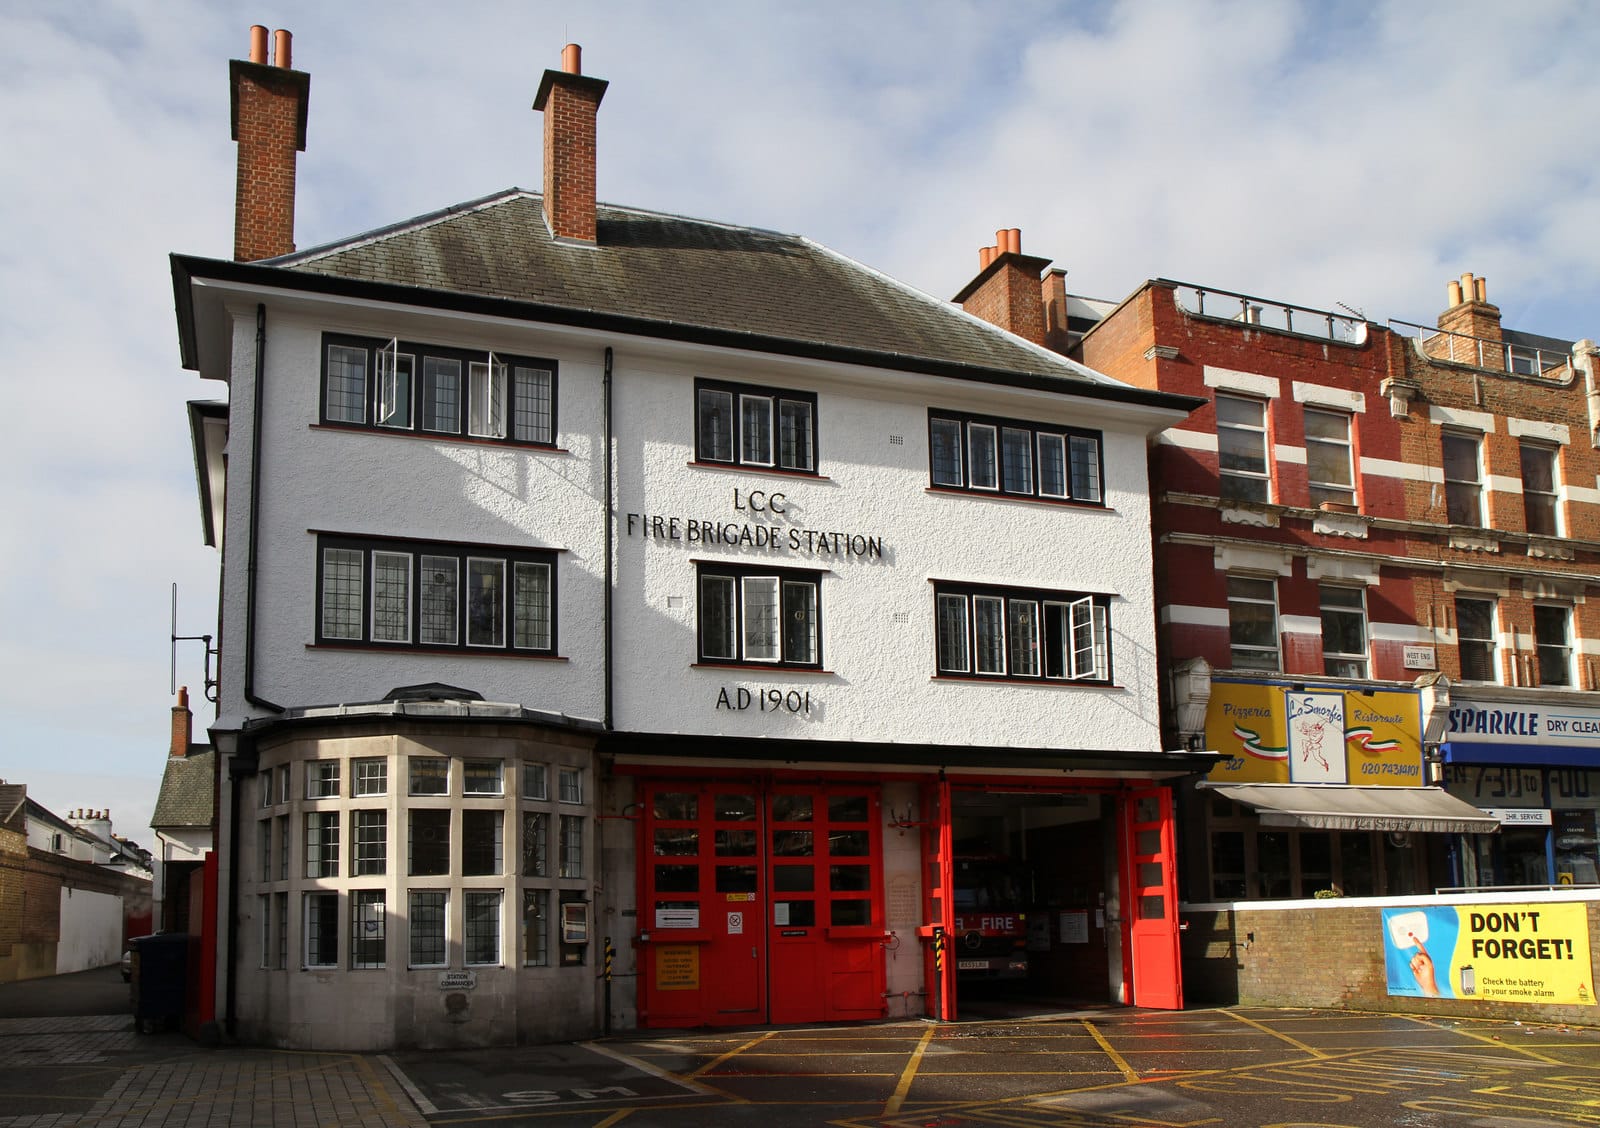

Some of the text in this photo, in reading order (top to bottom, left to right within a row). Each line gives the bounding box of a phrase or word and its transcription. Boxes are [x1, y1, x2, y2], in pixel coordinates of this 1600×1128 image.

[734, 488, 786, 514] LCC
[627, 513, 883, 558] FIRE BRIGADE STATION
[1420, 652, 1431, 660] END
[760, 688, 809, 713] 1901
[1223, 703, 1272, 720] Pizzeria
[1289, 697, 1342, 723] La Smorfia
[1353, 709, 1404, 724] Ristorante
[1448, 708, 1600, 736] SPARKLE DRY CLEA
[1361, 762, 1380, 775] 020
[1524, 774, 1537, 792] to
[981, 917, 1014, 930] FIRE
[1470, 911, 1540, 933] DON'T
[1472, 938, 1574, 960] FORGET!
[1482, 977, 1545, 989] Check the battery
[1483, 987, 1555, 997] in your smoke alarm
